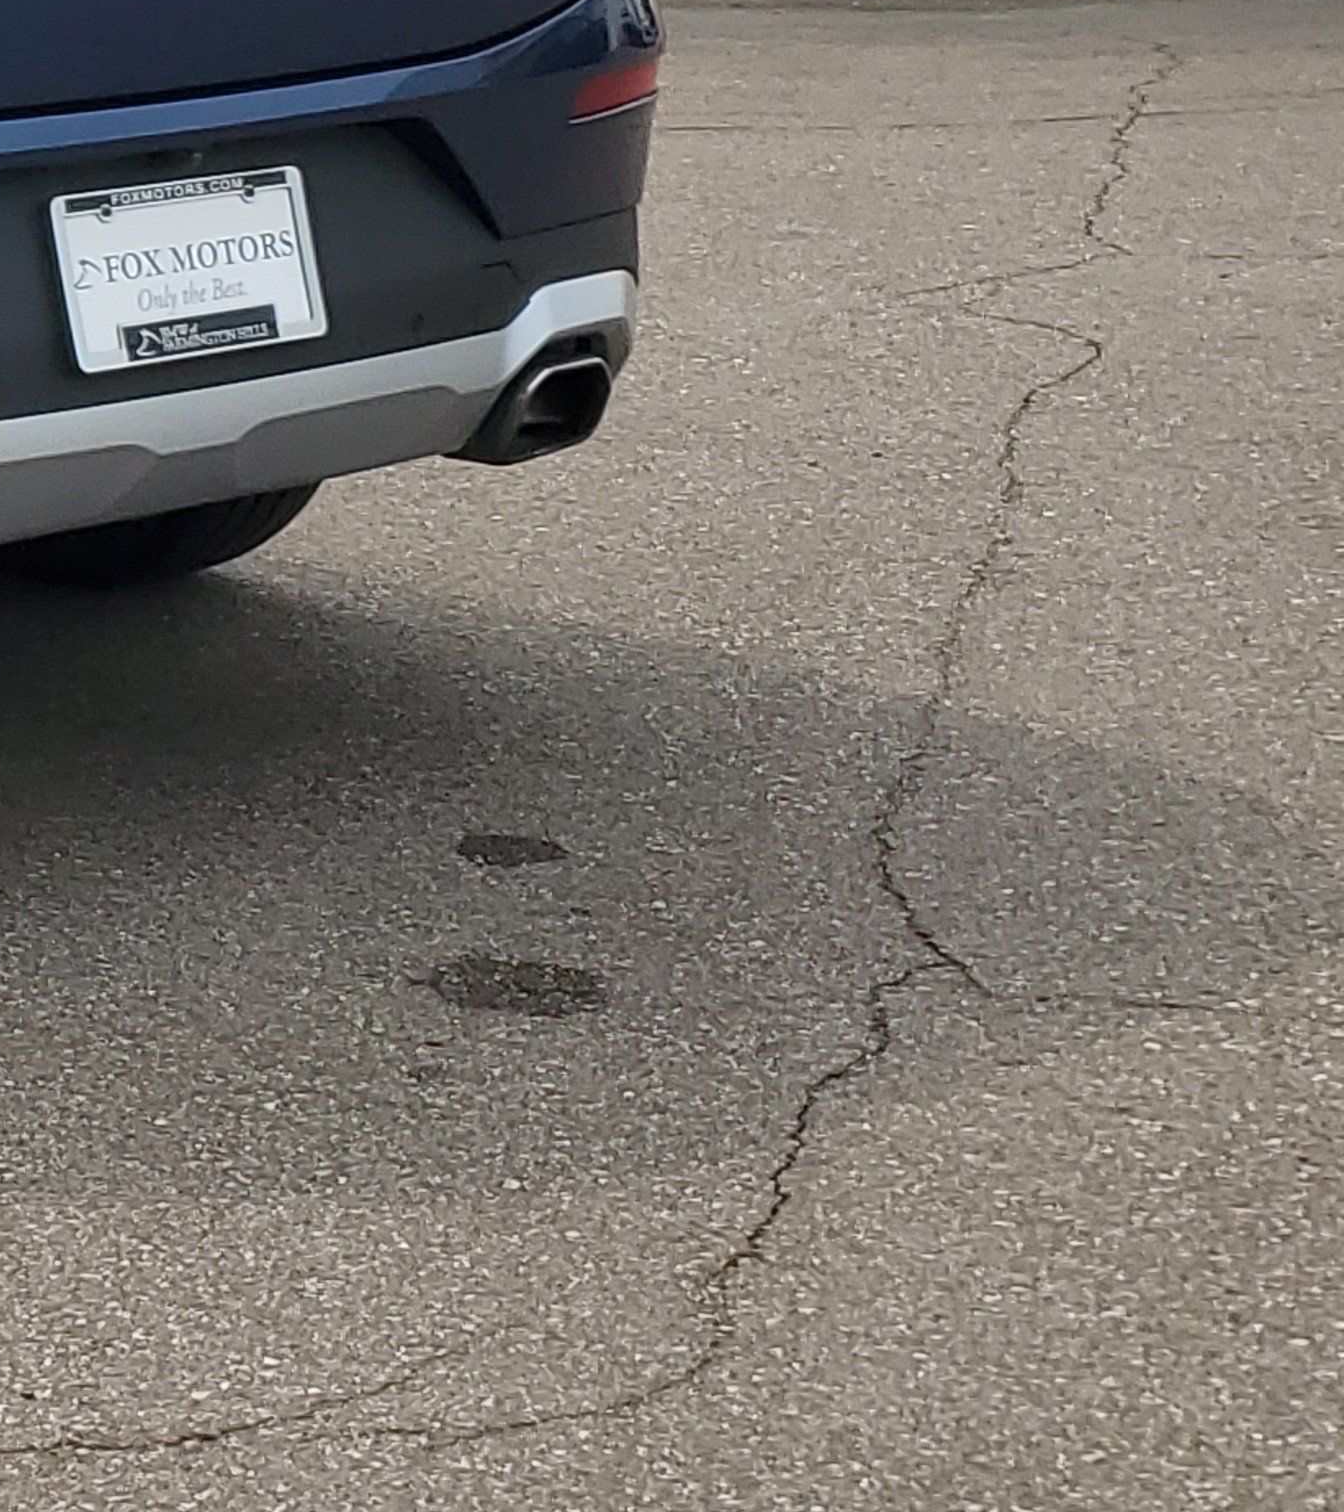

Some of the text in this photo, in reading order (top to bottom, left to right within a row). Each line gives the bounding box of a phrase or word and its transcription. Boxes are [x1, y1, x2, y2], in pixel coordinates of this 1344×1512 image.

[110, 177, 244, 206] FOXMOTORS.COM
[103, 229, 295, 283] FOX MOTORS
[138, 283, 177, 314] Only
[182, 280, 206, 303] the
